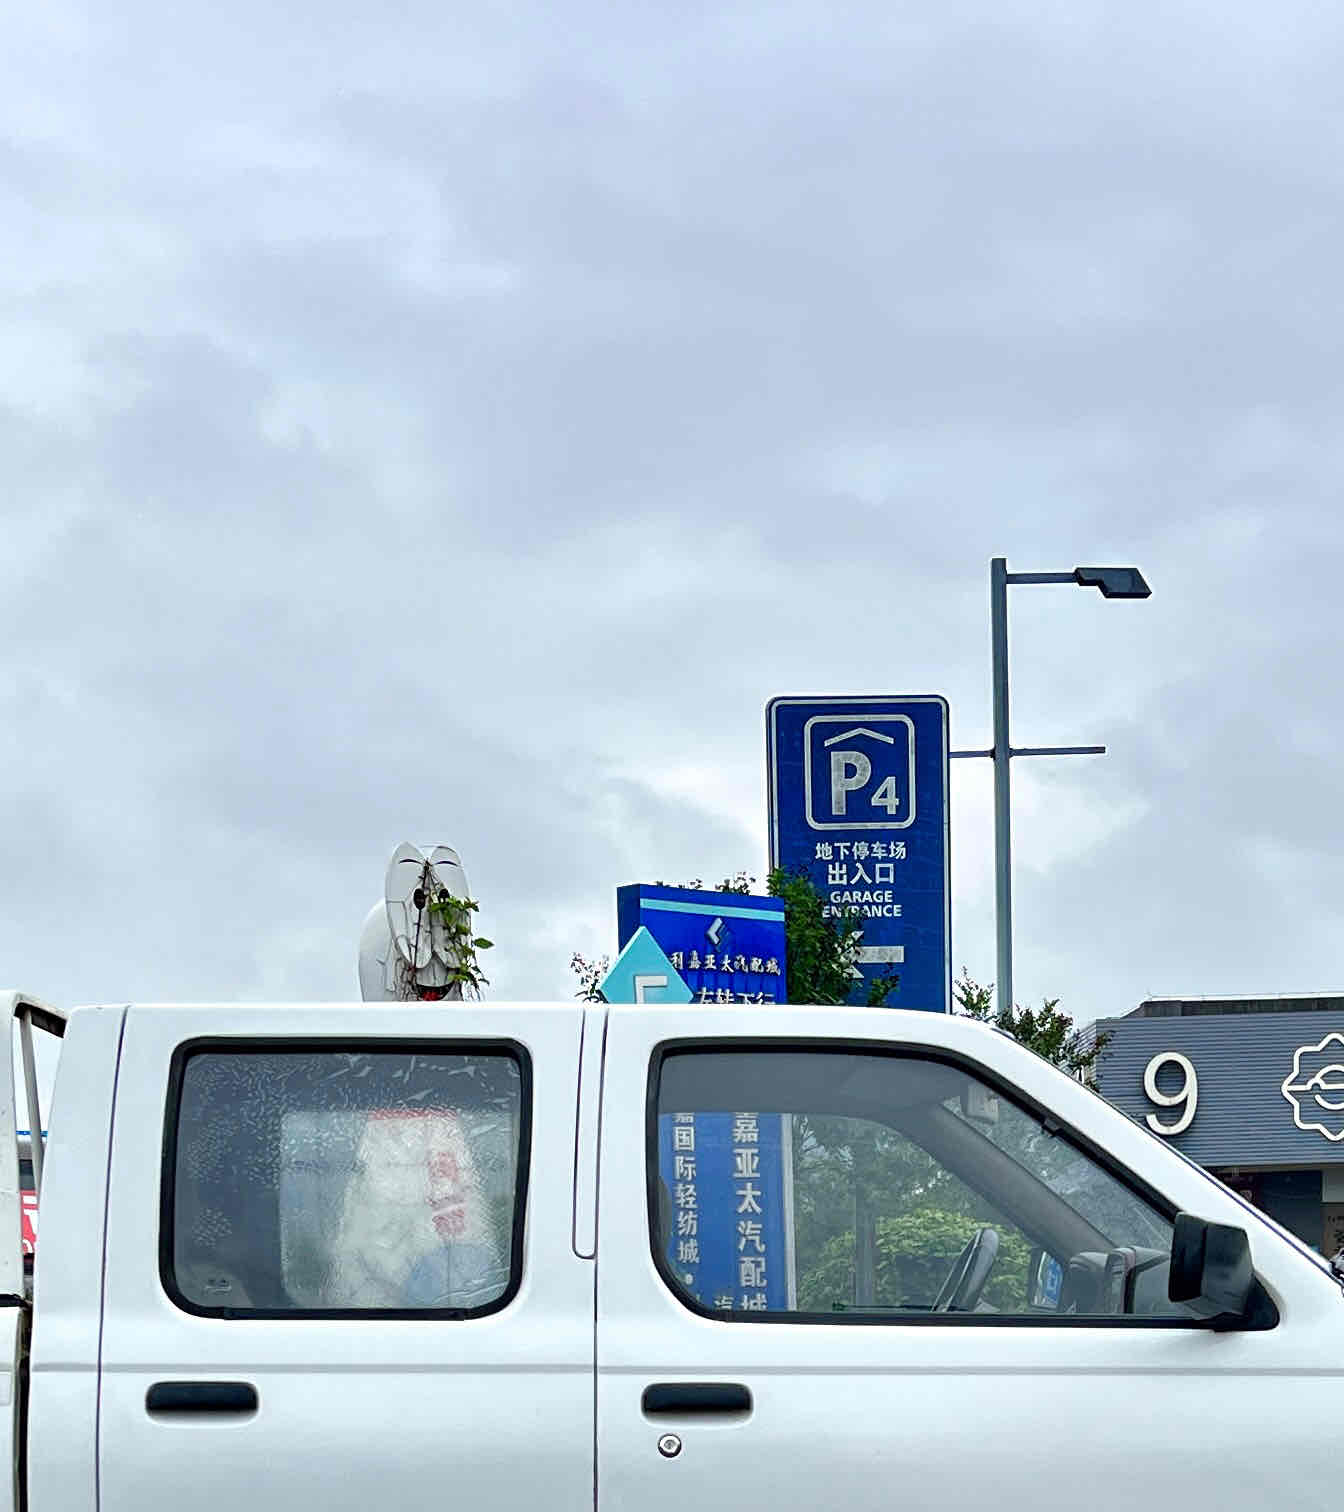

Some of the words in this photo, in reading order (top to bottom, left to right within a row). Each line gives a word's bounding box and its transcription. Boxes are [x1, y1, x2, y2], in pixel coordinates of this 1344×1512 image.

[831, 751, 899, 815] P4
[815, 841, 906, 861] 地下停车场
[827, 862, 895, 885] 出入口
[830, 890, 893, 903] GARAGE
[671, 950, 782, 976] 利嘉亚太汽配城
[1142, 1051, 1198, 1137] 9
